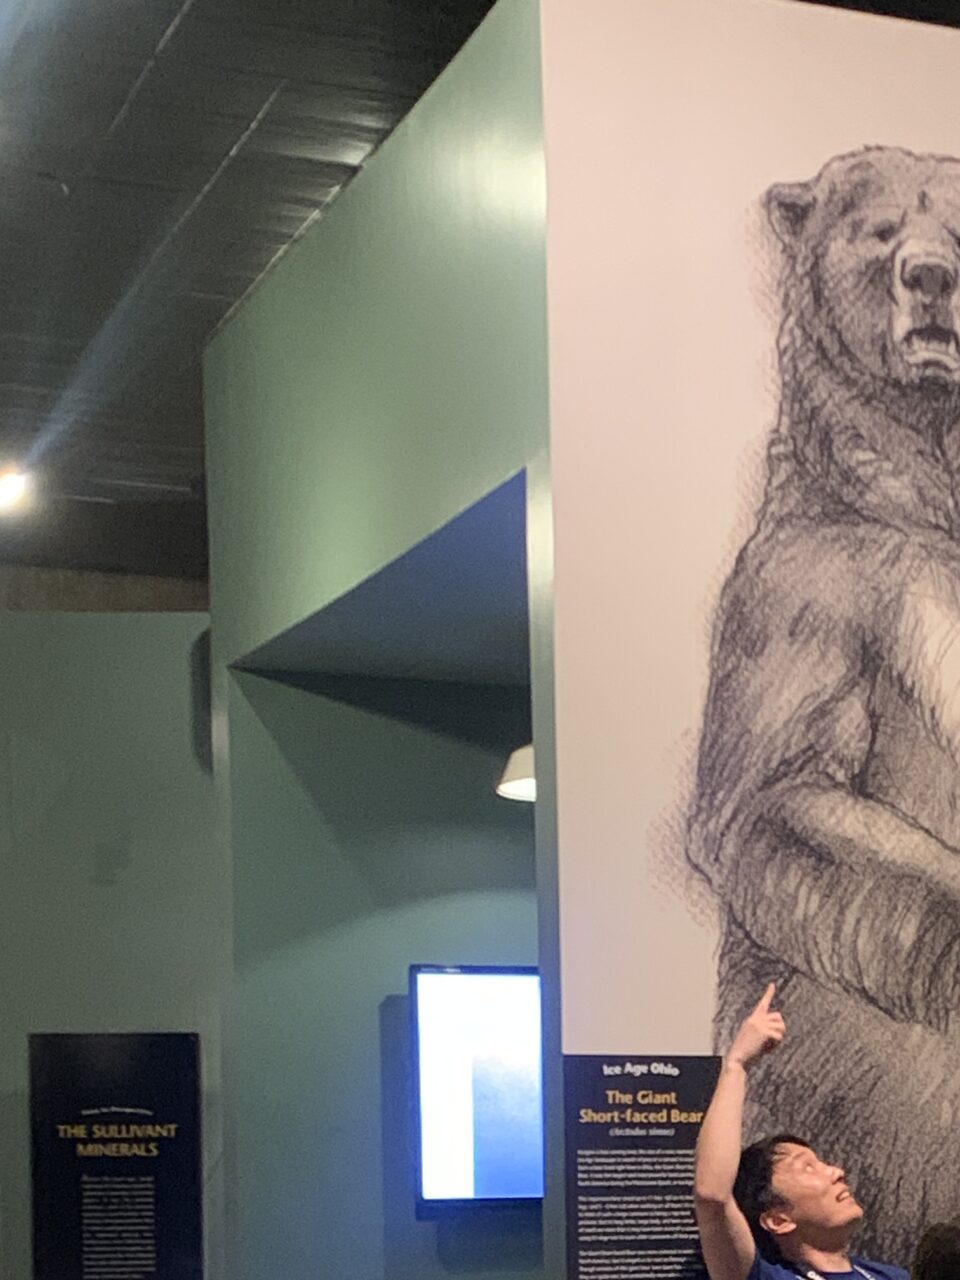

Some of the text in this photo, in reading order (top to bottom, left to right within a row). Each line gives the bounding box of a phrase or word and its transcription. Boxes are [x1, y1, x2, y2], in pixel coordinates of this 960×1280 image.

[602, 1062, 680, 1076] Ice Age Ohio
[606, 1090, 677, 1104] The Giant
[579, 1108, 703, 1123] Short-faced Bear
[57, 1123, 178, 1138] THE SULLIVANT
[76, 1142, 159, 1156] MINERALS
